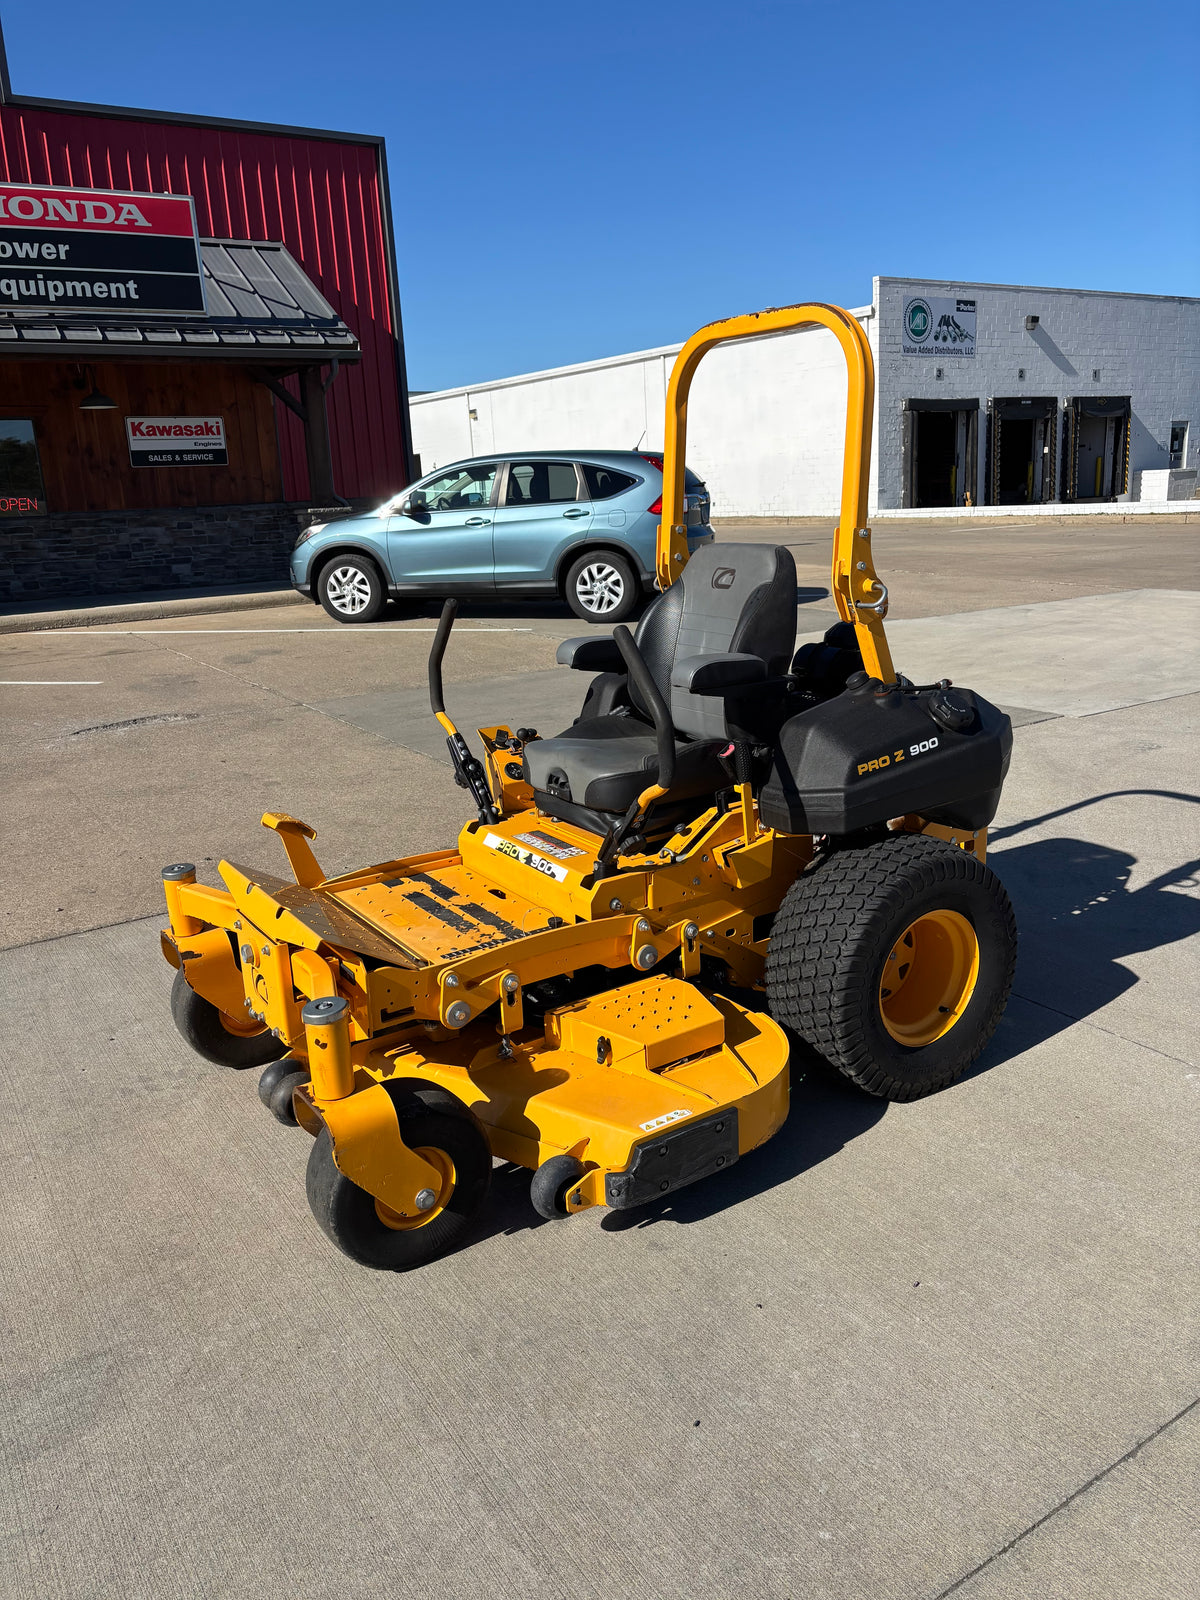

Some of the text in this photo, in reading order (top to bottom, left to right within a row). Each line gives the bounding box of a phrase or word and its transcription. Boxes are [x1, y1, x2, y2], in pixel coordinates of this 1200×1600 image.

[0, 195, 152, 227] ONDA
[903, 345, 974, 355] Value Added Distributors, LLC
[130, 421, 221, 437] Kawasaki
[148, 454, 173, 462] SALES
[182, 453, 214, 461] SERVICE
[0, 497, 38, 511] OPEN
[857, 737, 939, 776] PRO Z 900
[497, 840, 519, 857] PRO
[530, 858, 554, 875] 900
